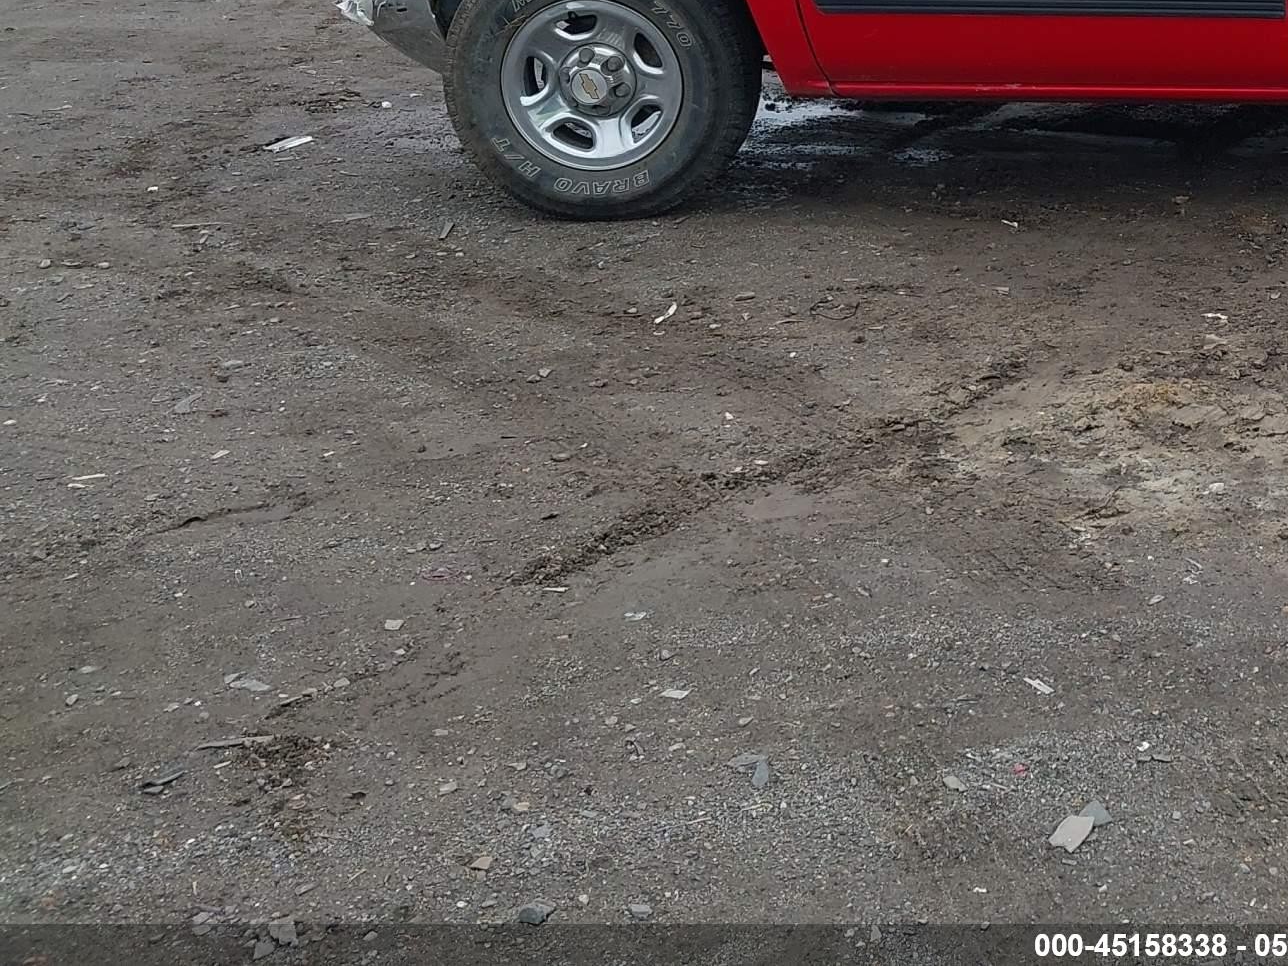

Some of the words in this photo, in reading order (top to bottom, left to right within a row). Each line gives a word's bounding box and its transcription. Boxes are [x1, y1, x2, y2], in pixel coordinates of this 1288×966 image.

[650, 0, 696, 49] 770
[489, 136, 542, 180] H/T
[553, 168, 651, 196] BRAVO
